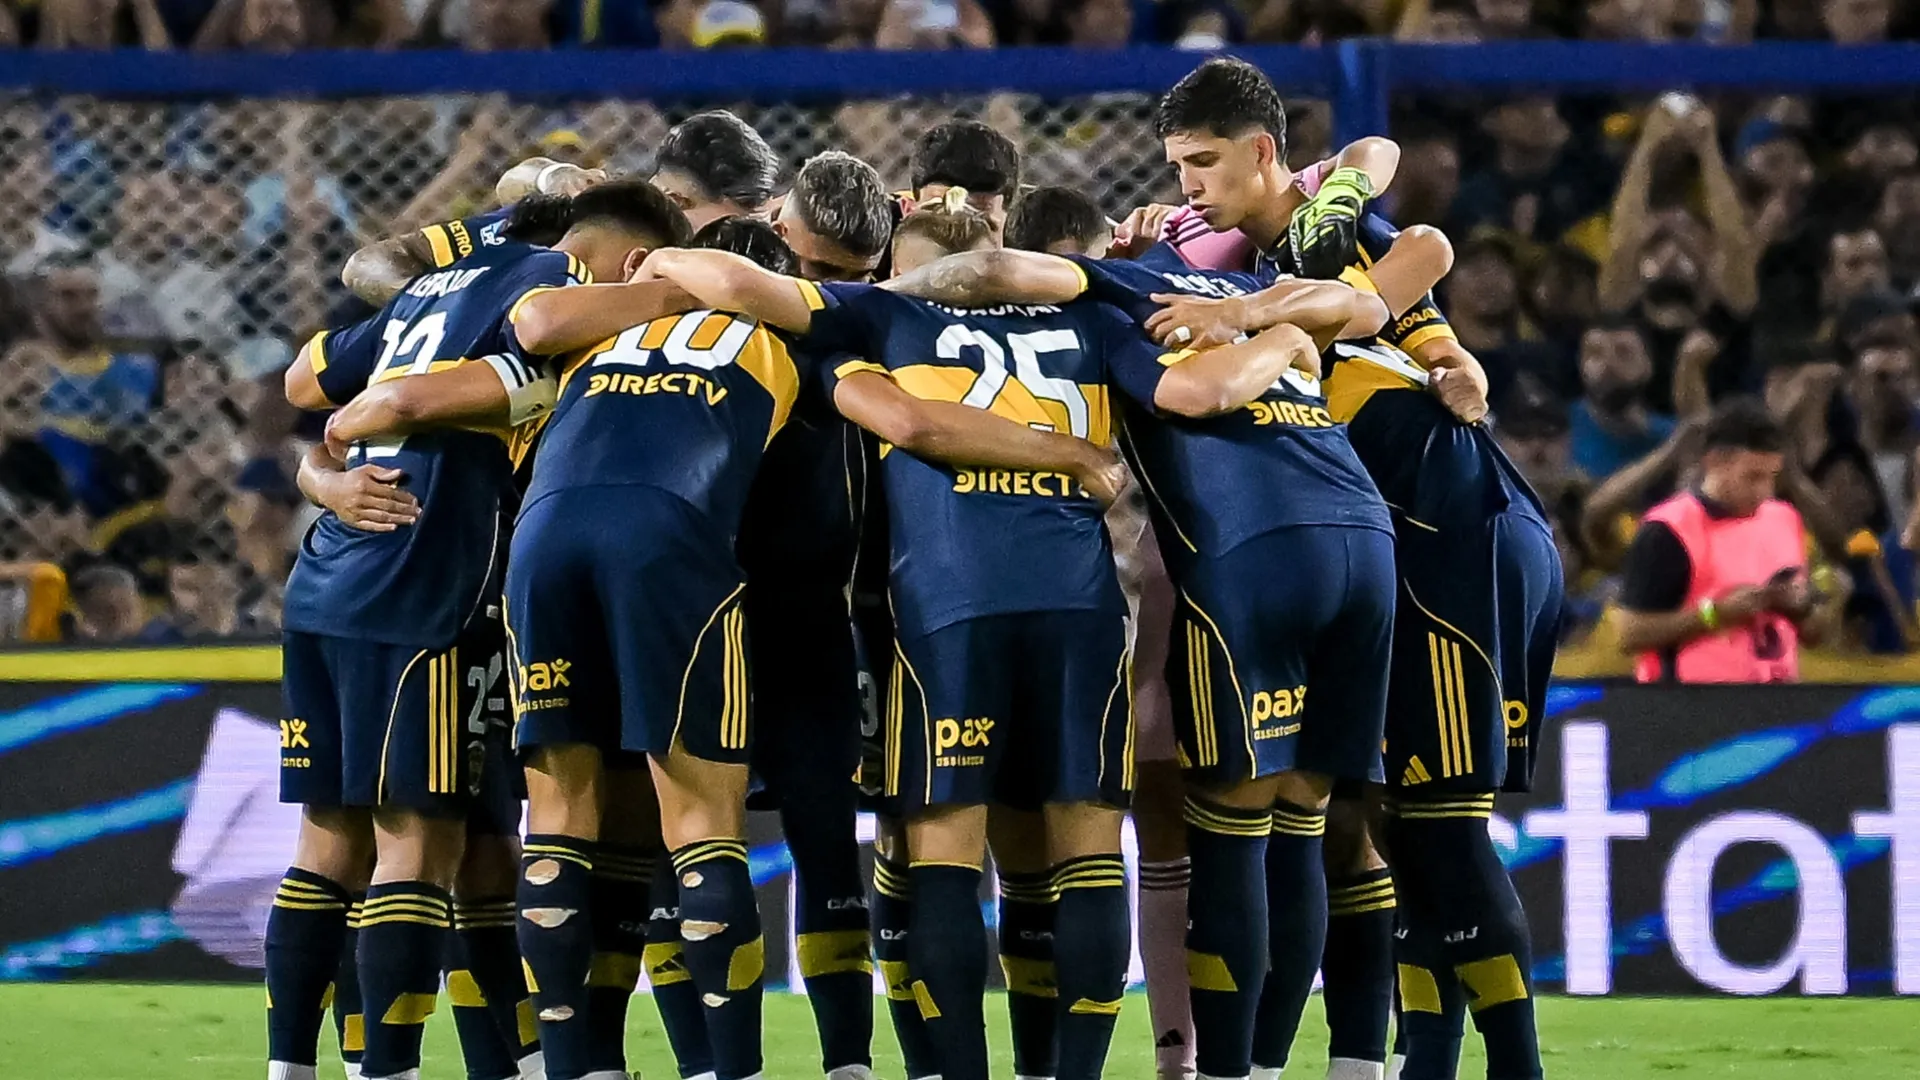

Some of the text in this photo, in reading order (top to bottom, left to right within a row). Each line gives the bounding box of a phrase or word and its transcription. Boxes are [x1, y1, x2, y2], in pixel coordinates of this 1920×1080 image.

[592, 308, 755, 370] 10
[584, 372, 728, 406] DIRECTV
[935, 323, 1088, 439] 25
[952, 470, 1090, 499] DIRECT
[1252, 685, 1307, 729] pax
[935, 717, 995, 756] pax
